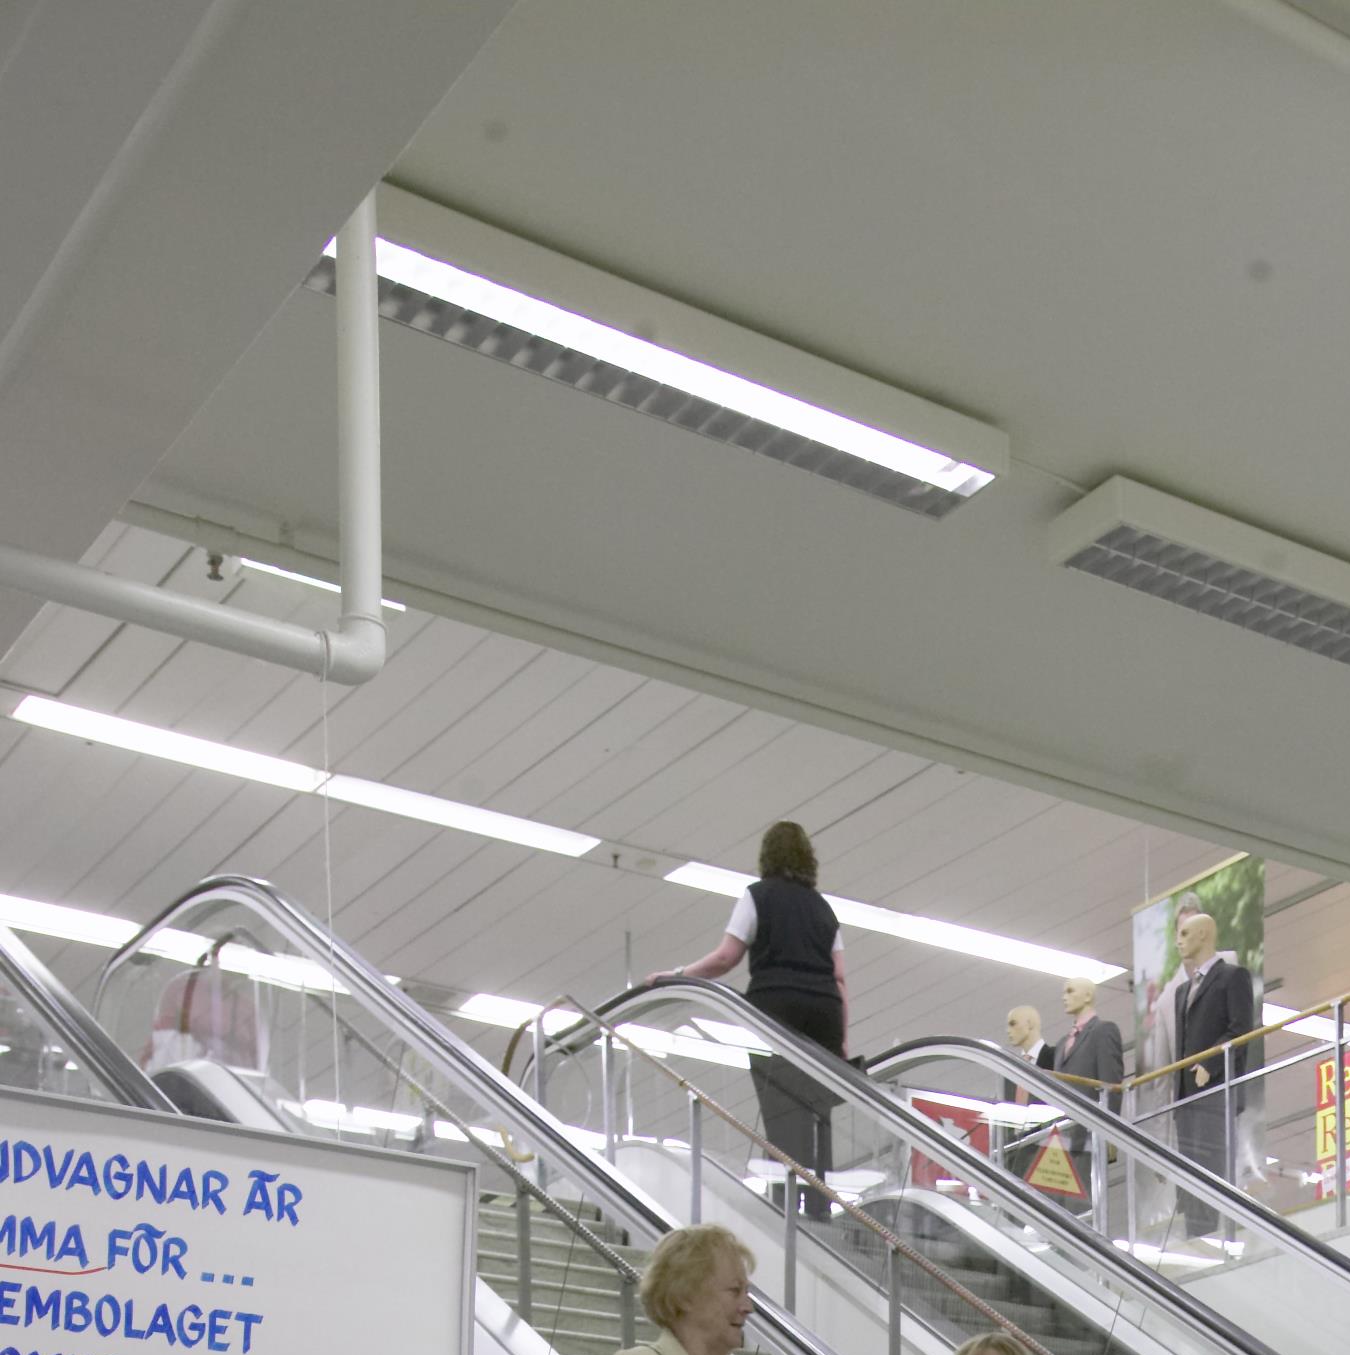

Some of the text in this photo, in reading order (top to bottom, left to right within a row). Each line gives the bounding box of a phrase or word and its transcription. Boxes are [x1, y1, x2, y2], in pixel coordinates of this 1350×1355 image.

[242, 1169, 304, 1227] ÄR
[105, 1222, 188, 1280] FÖR
[0, 1281, 264, 1354] EMBOLAGET
